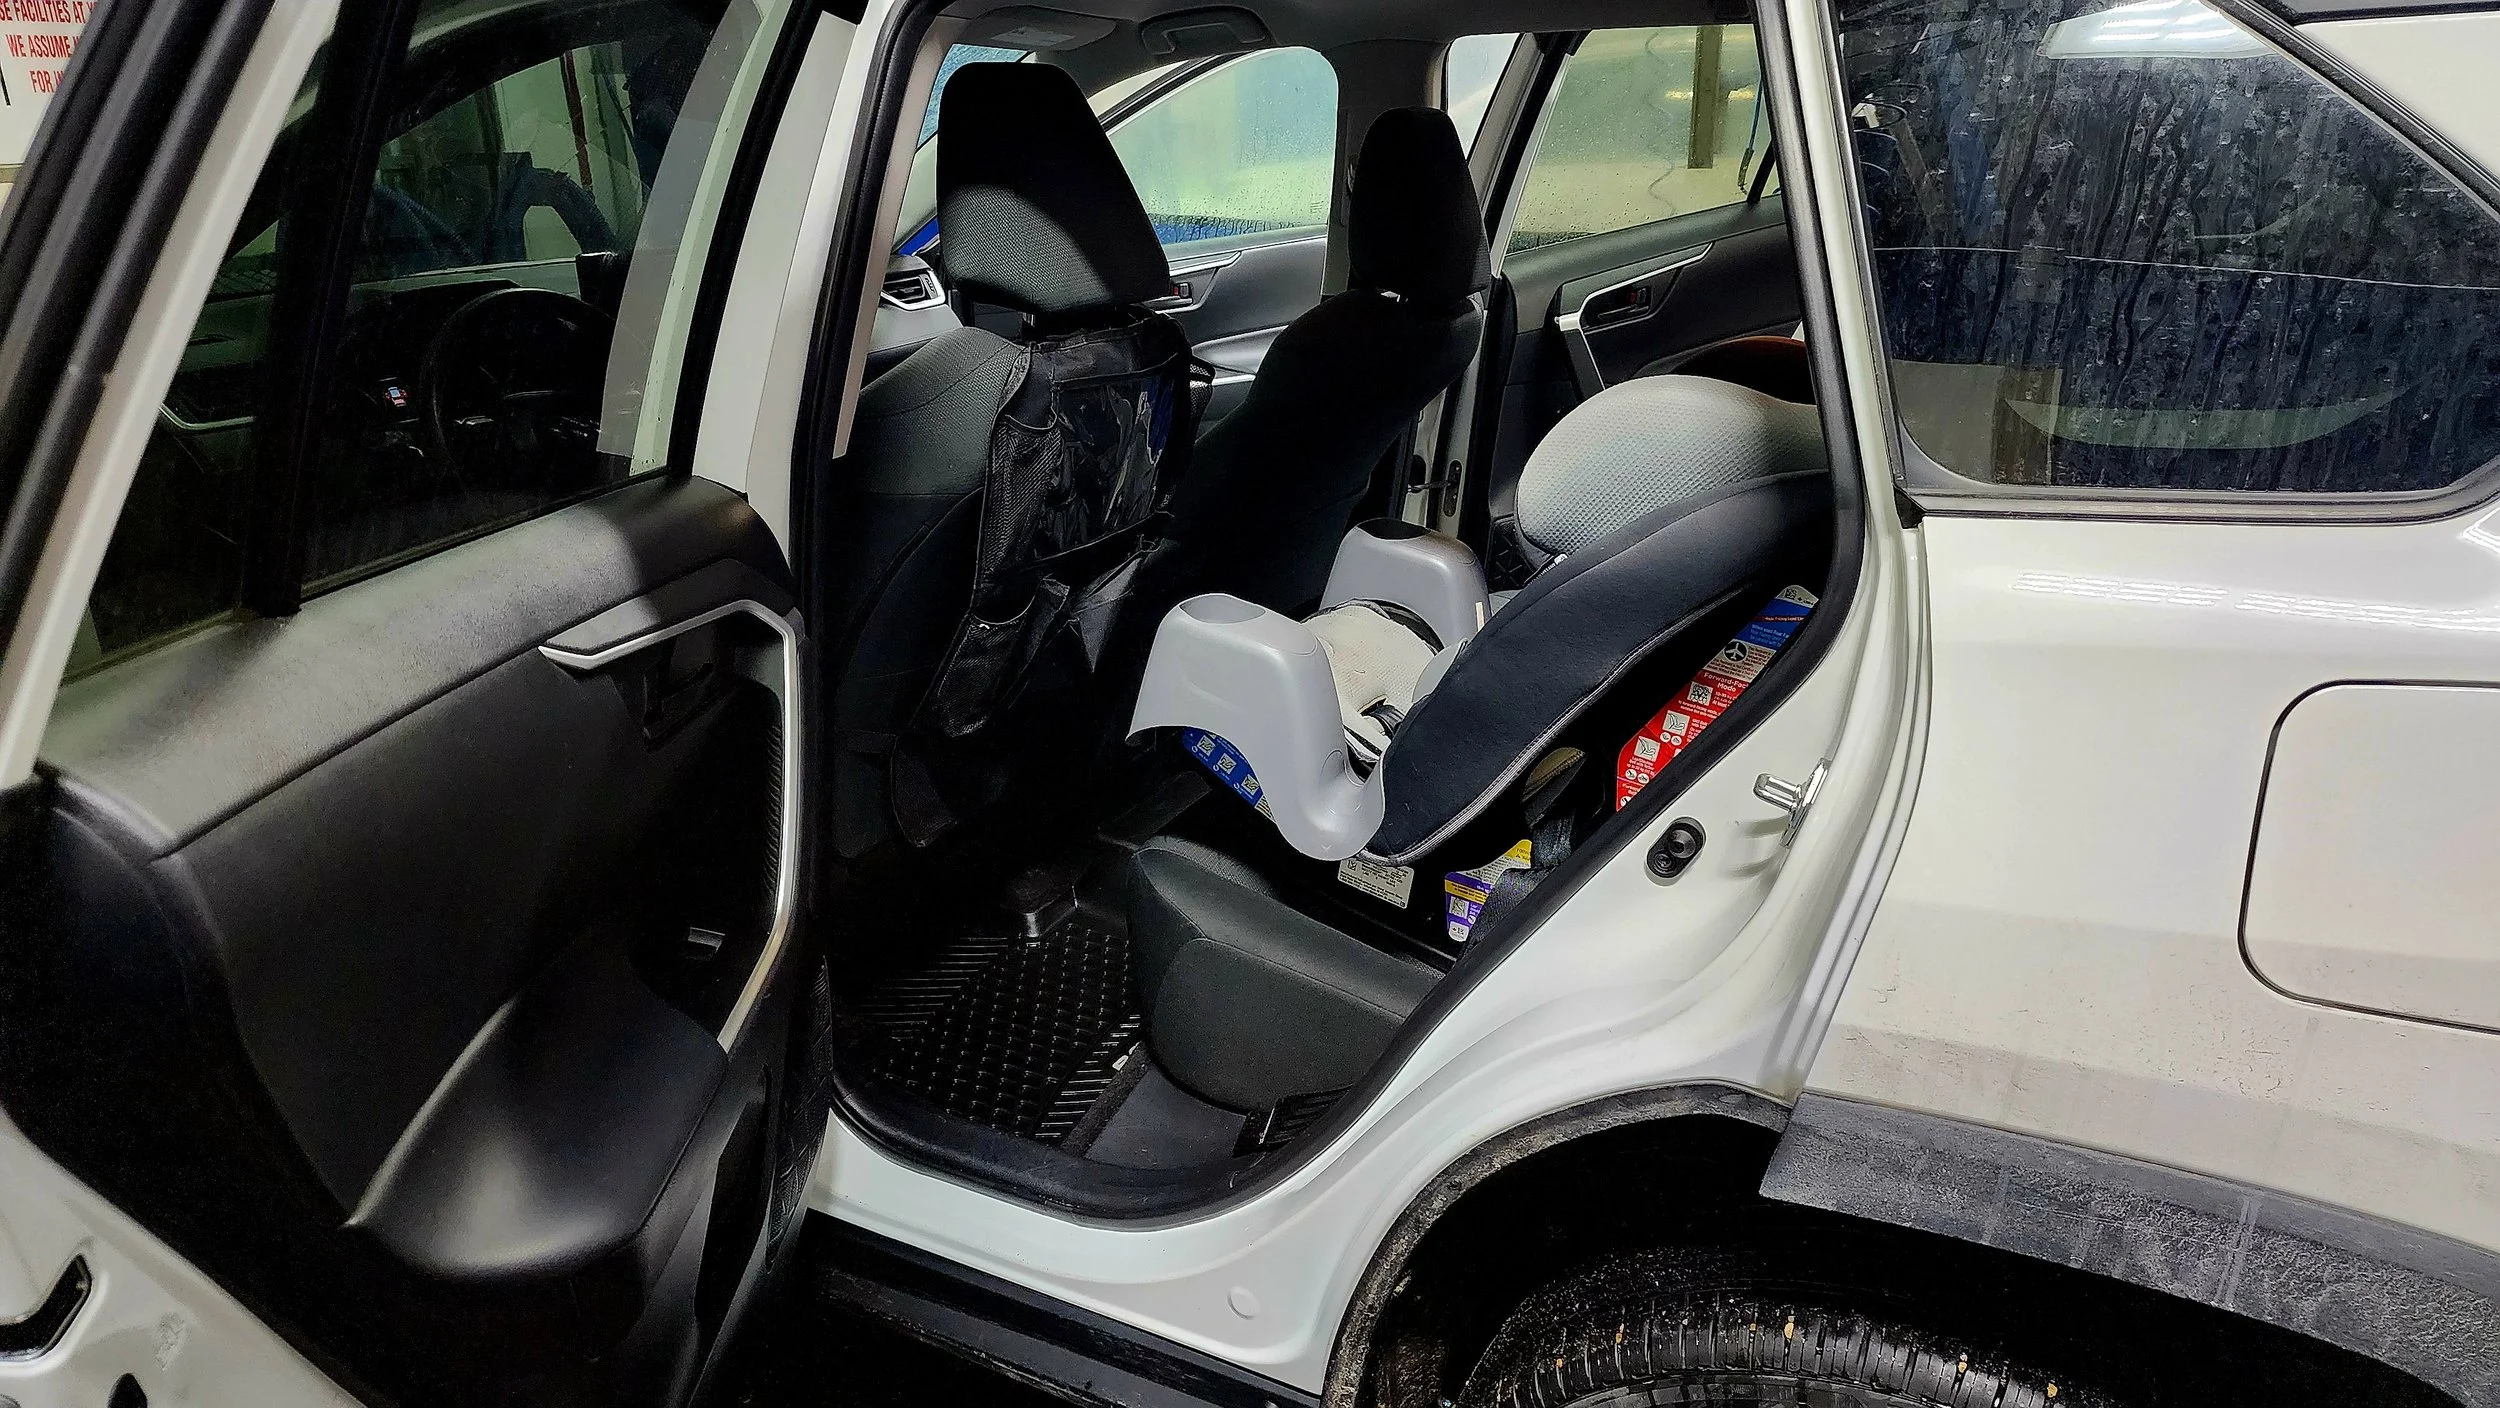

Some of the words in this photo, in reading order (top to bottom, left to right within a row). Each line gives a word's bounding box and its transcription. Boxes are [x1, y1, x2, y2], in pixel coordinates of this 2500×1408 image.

[13, 0, 71, 23] FACILITIES
[73, 1, 86, 24] AT
[6, 34, 26, 57] WE
[28, 34, 72, 58] ASSUME
[29, 70, 55, 93] FOR
